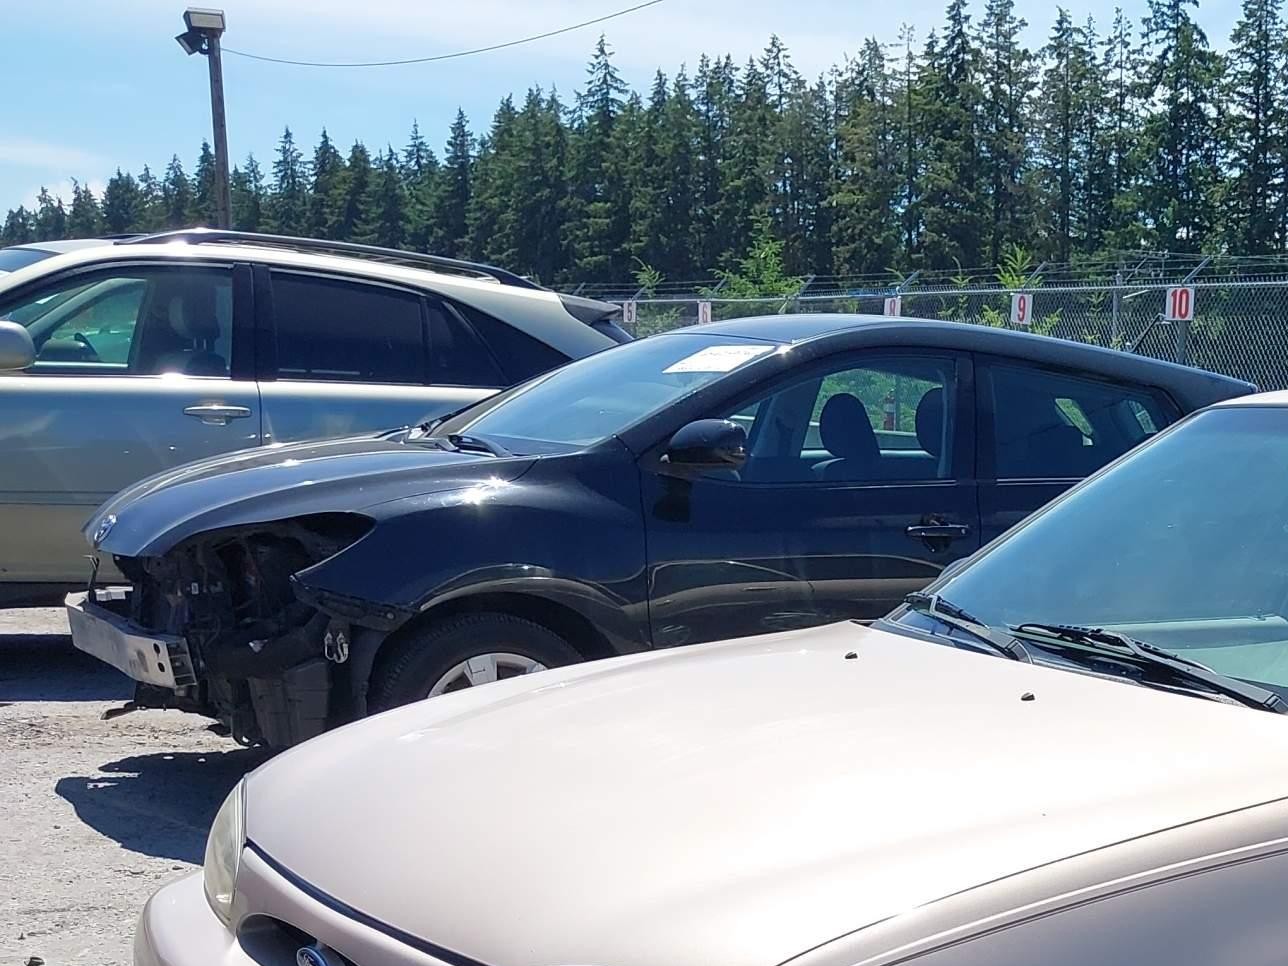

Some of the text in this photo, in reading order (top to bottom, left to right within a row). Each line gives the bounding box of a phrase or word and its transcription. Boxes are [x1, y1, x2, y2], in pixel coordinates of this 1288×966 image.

[626, 303, 633, 321] 5
[1017, 295, 1026, 321] 9
[1170, 288, 1190, 319] 10
